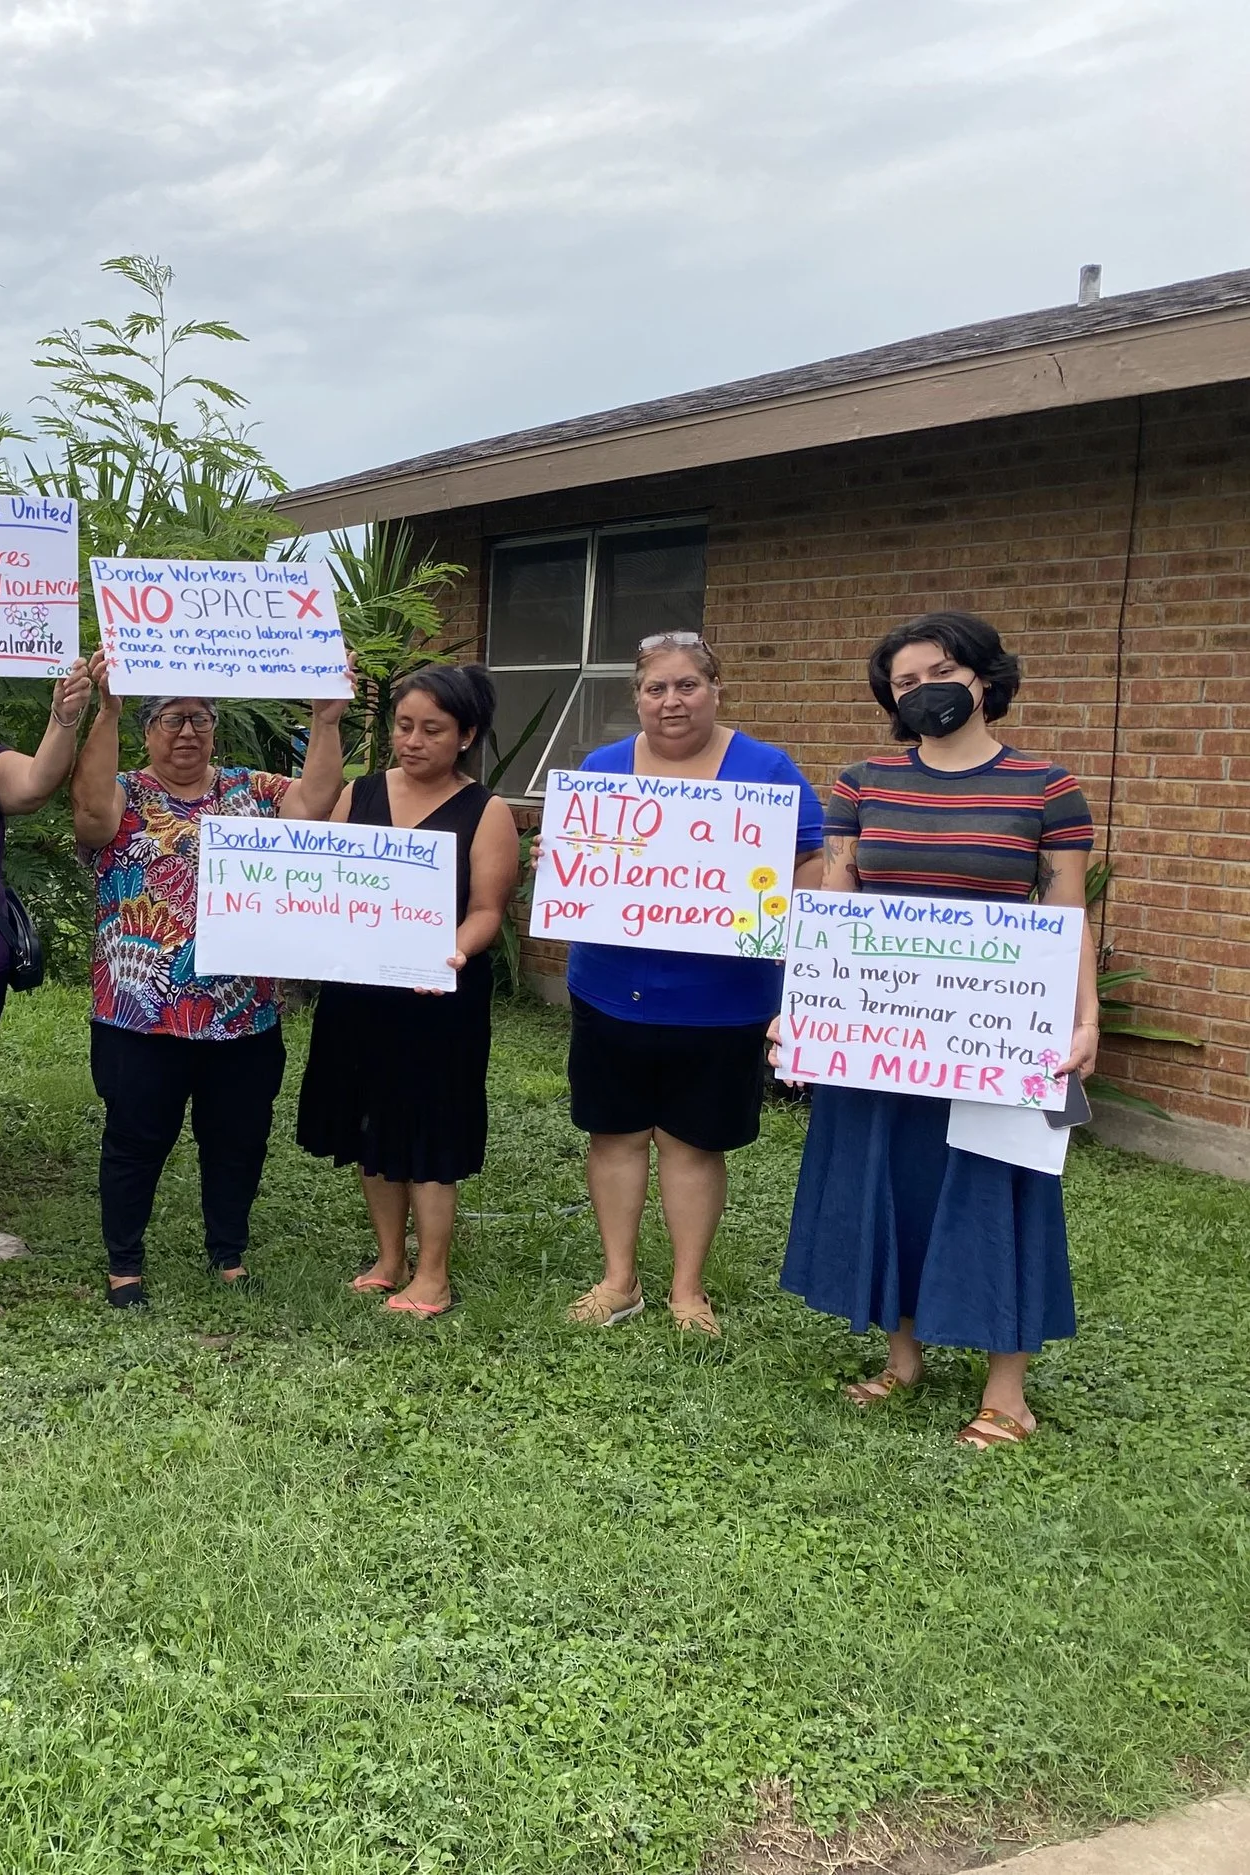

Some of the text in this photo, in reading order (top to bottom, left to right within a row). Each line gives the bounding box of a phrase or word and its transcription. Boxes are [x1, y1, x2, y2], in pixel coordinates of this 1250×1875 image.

[12, 498, 72, 524] United
[92, 559, 308, 585] Border Workers United
[100, 585, 174, 625] NO
[118, 641, 166, 653] causa
[146, 627, 163, 639] es
[170, 627, 189, 639] un
[195, 625, 251, 646] espacio
[255, 625, 302, 641] laboral
[123, 658, 164, 674] pone
[169, 660, 187, 670] en
[193, 660, 240, 677] riesgo
[247, 664, 257, 673] a
[260, 663, 296, 673] varias
[553, 772, 793, 808] Border Workers United
[563, 792, 762, 848] ALTO a la
[203, 822, 438, 865] Border Workers United
[208, 858, 390, 892] If We pay taxes
[552, 850, 732, 893] Violencia
[207, 892, 444, 928] LNG should pay taxes
[538, 899, 735, 937] por genero
[795, 892, 1064, 935] Border Workers United
[793, 962, 820, 979] es
[832, 957, 851, 979] la
[860, 964, 921, 993] mejor
[787, 988, 1053, 1036] para terminar con la
[788, 1014, 1039, 1066] VIOLENCIA contra
[790, 1046, 1005, 1097] LA MUJER
